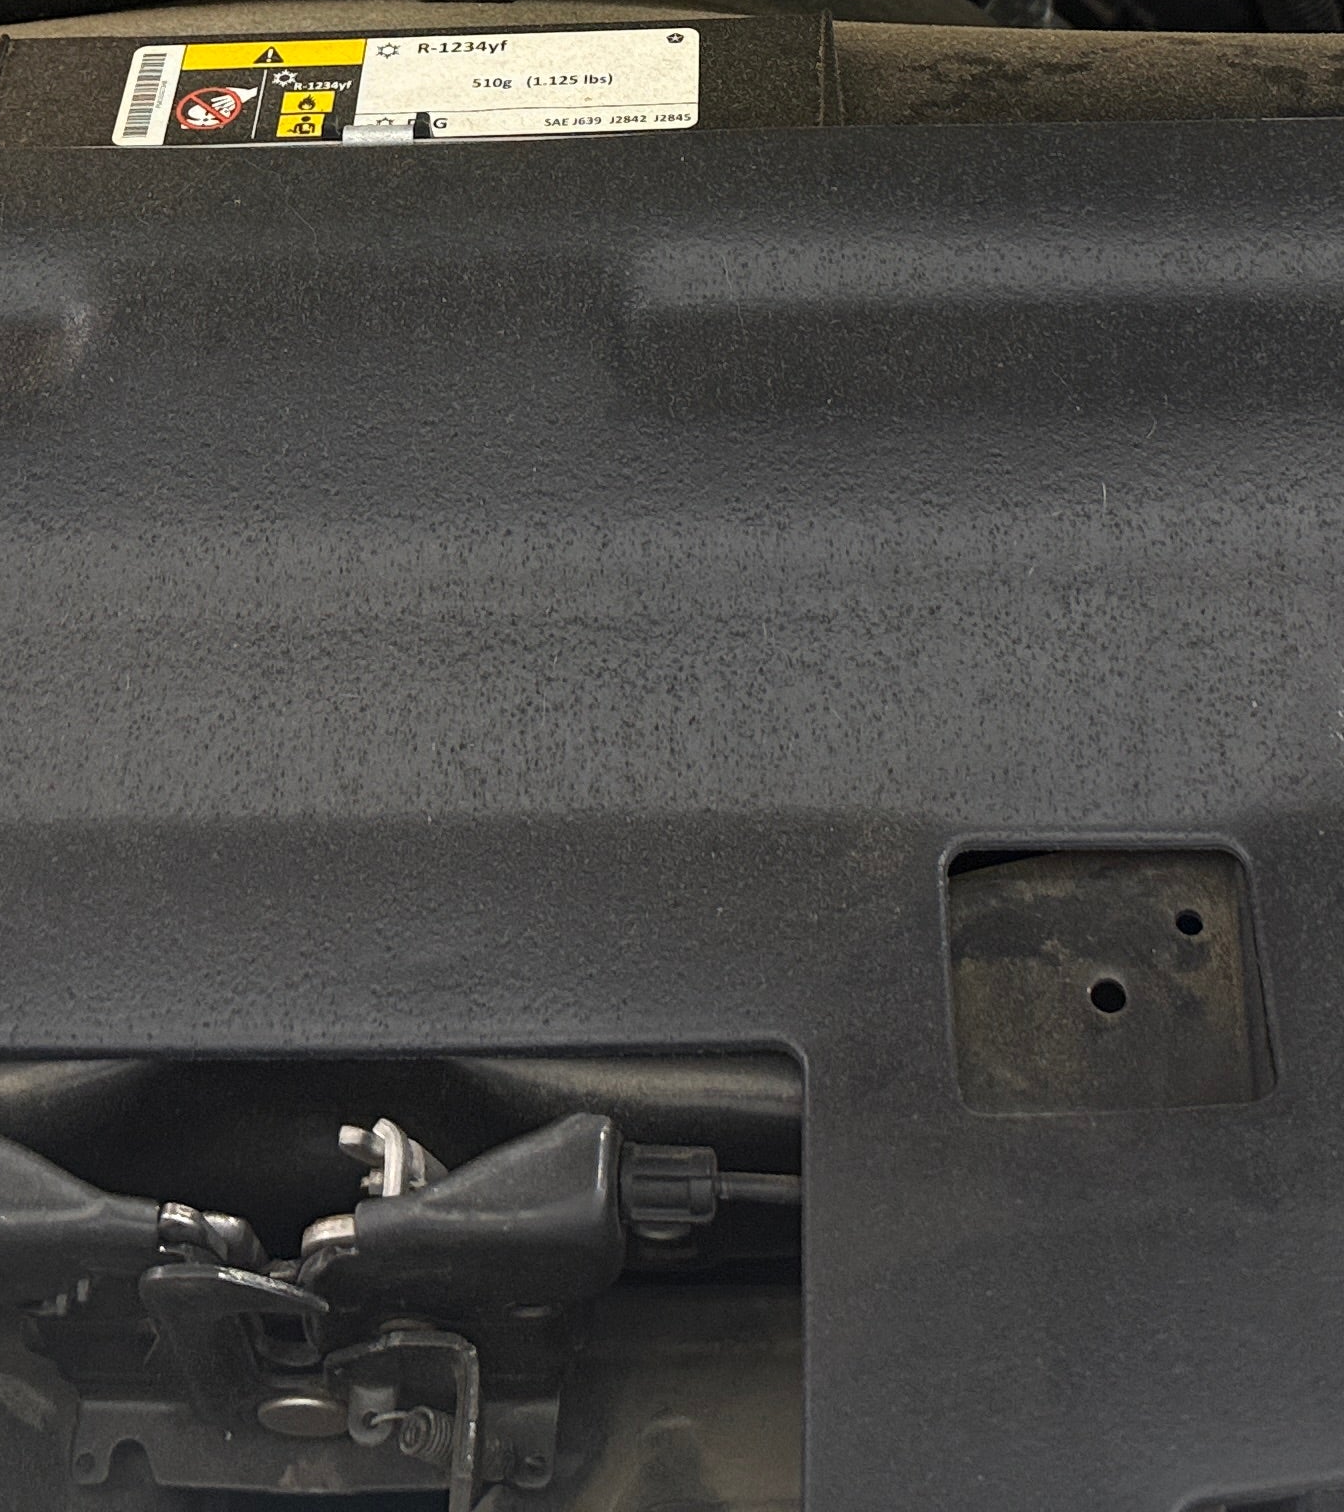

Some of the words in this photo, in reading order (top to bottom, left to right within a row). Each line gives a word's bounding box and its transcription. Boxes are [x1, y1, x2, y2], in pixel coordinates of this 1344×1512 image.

[417, 39, 508, 55] R-1234yf
[293, 79, 354, 92] R-1234yf
[471, 77, 513, 90] 510g
[526, 74, 578, 88] (1.125
[584, 72, 614, 86] lbs)
[544, 117, 569, 127] SAE
[572, 116, 602, 127] J639
[609, 114, 647, 125] J2842
[654, 113, 692, 123] J2845
